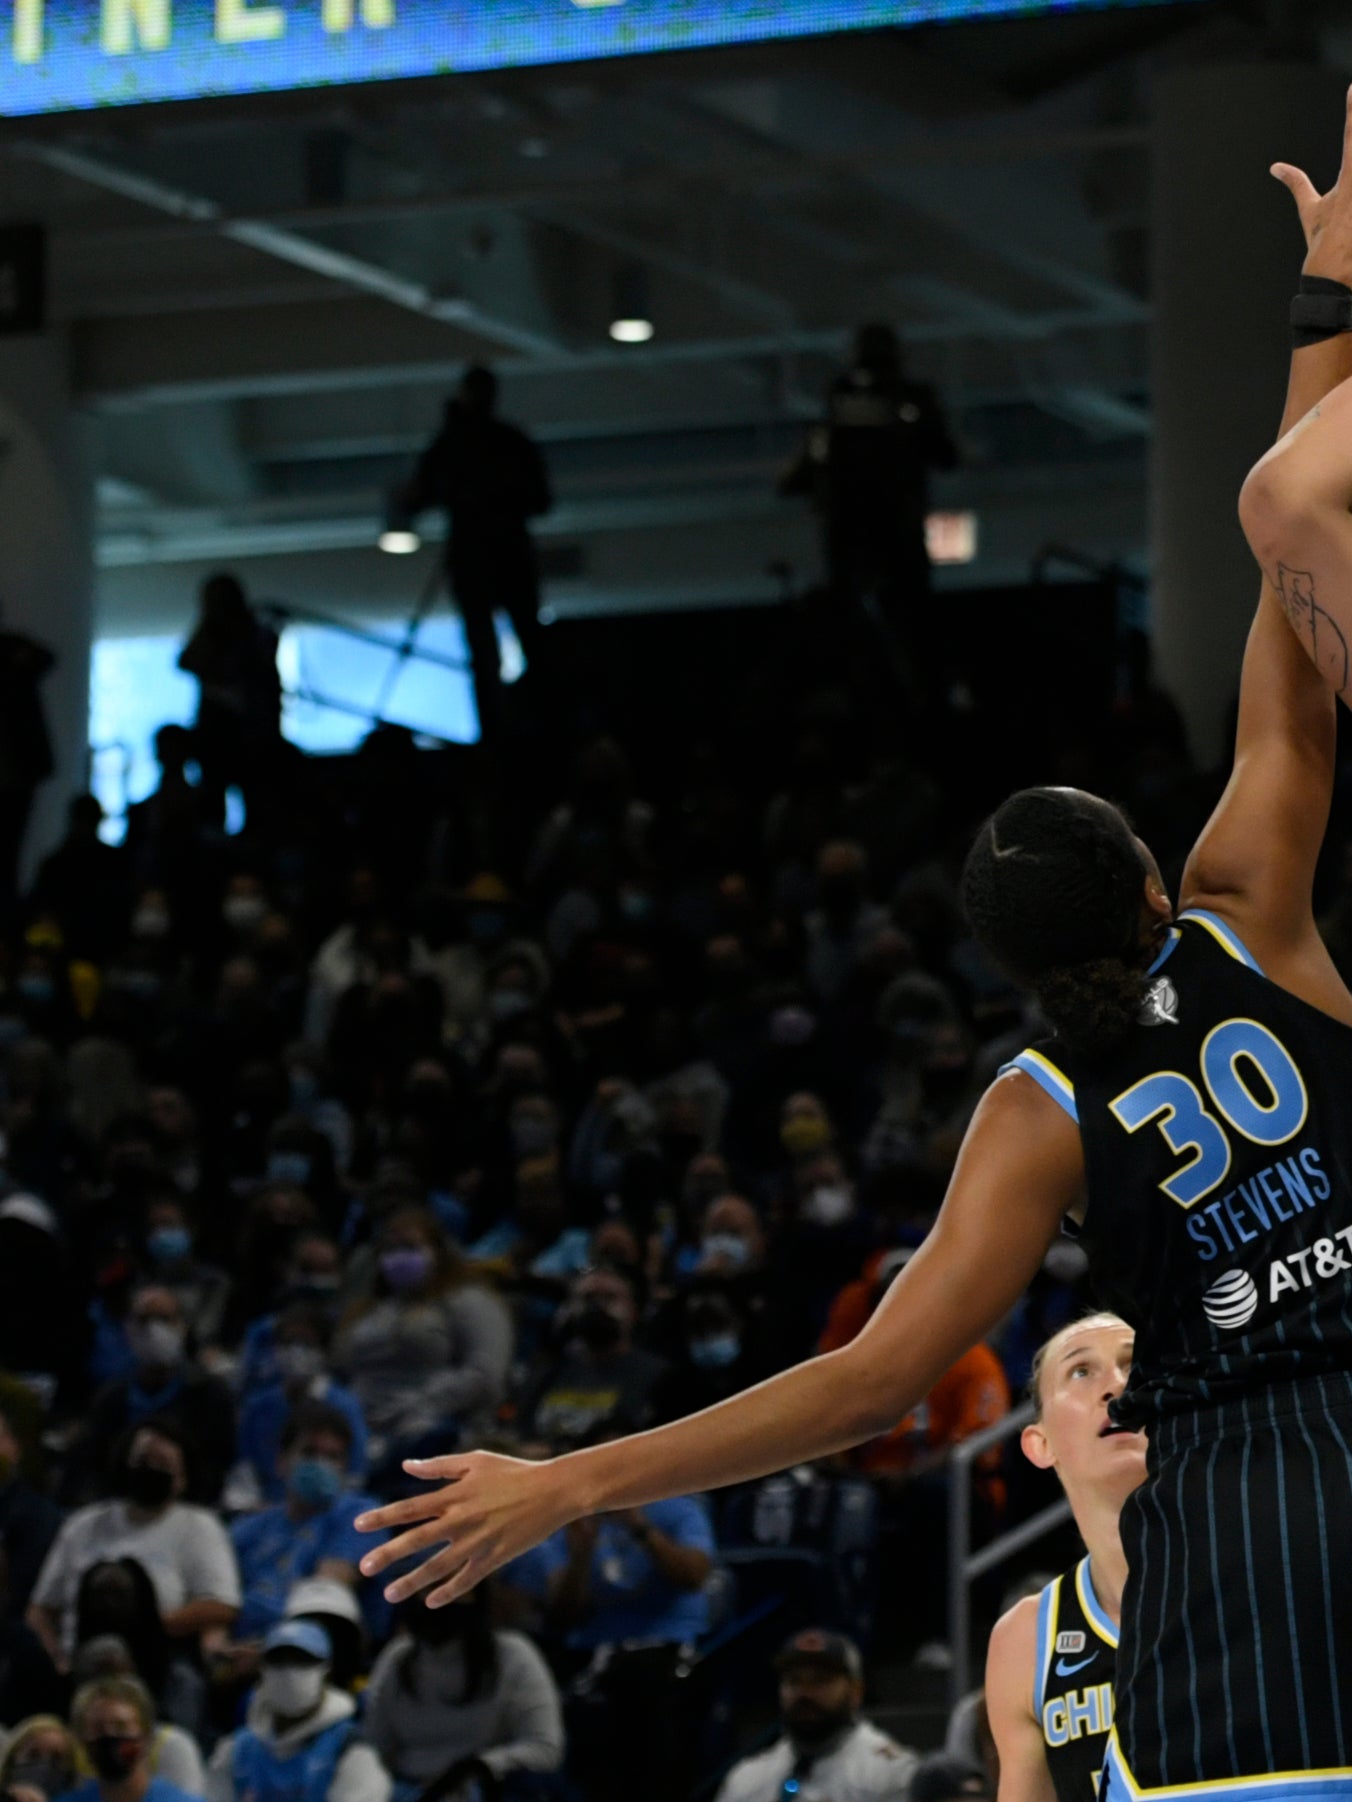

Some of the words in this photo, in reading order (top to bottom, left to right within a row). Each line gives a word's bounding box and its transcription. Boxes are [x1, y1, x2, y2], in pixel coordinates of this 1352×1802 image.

[1107, 1017, 1309, 1210] 30
[1185, 1147, 1332, 1262] STEVENS
[1042, 1681, 1116, 1748] CHI
